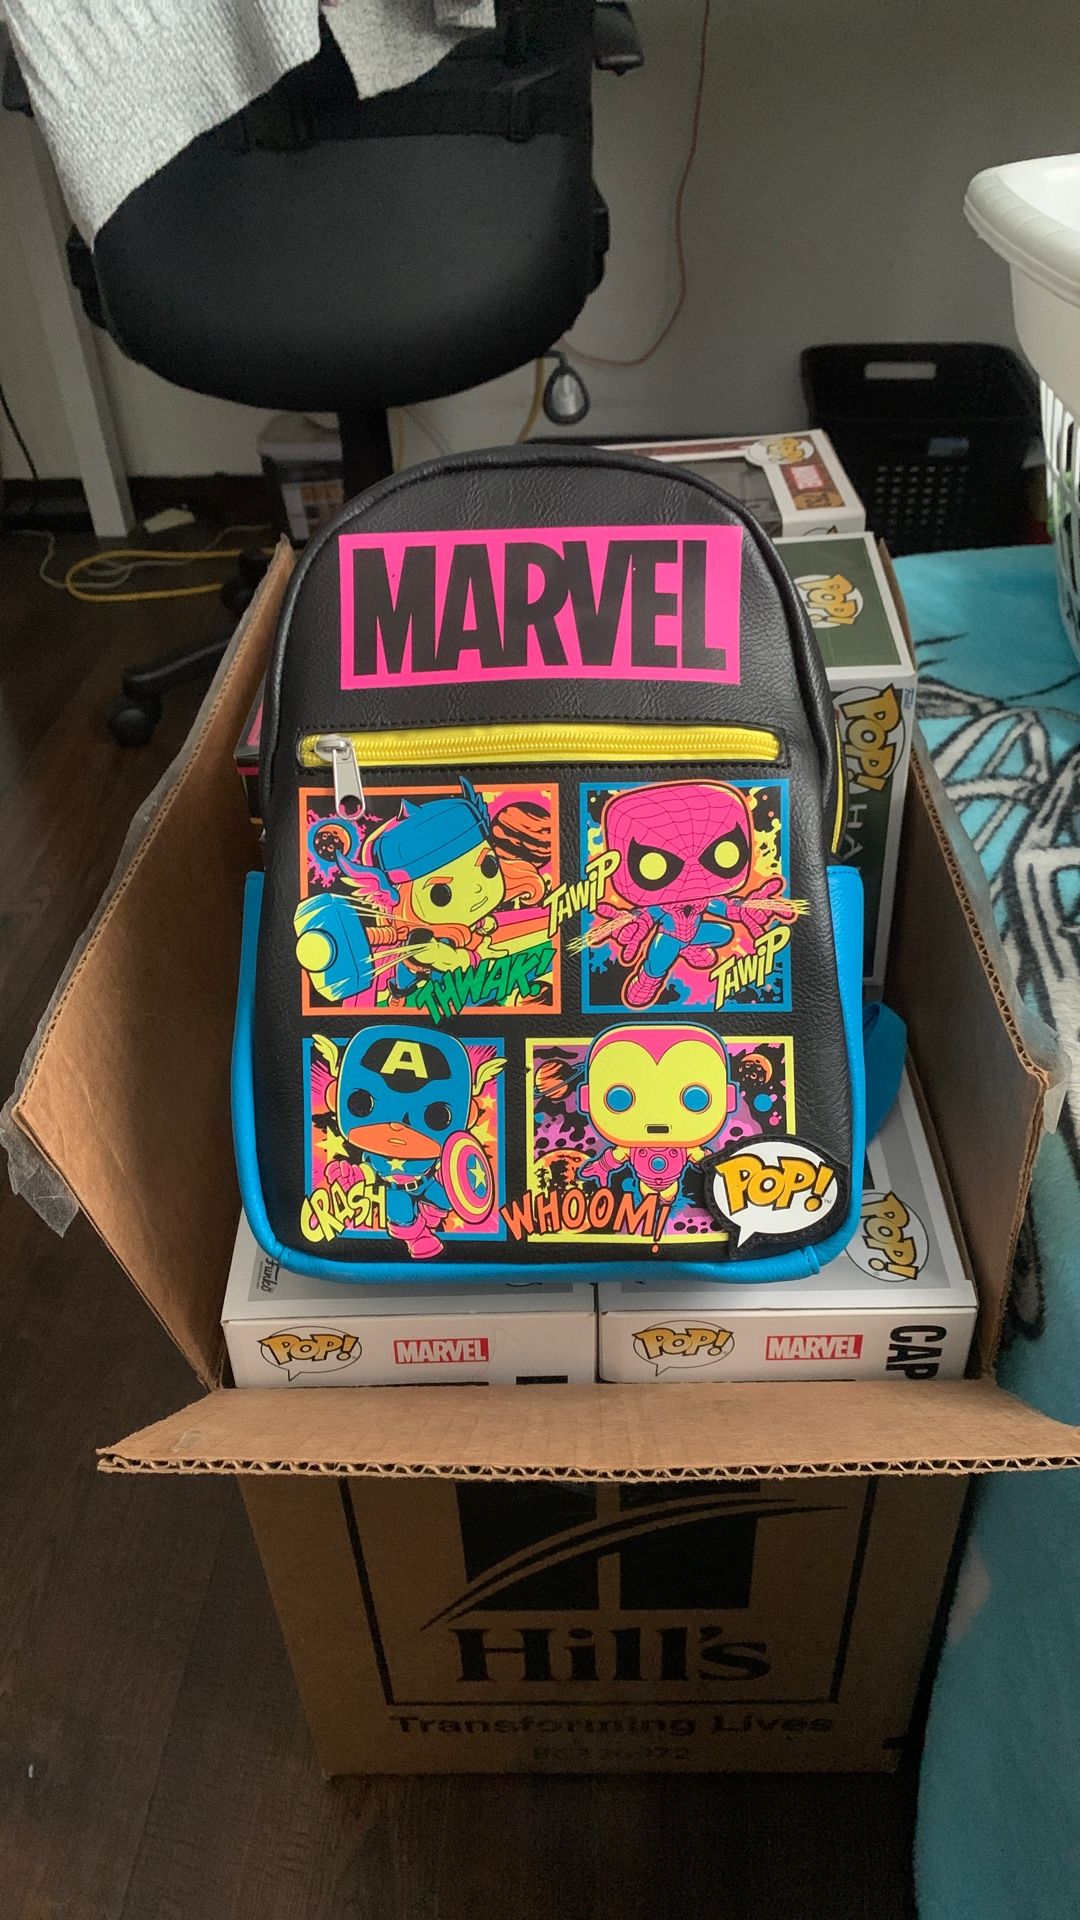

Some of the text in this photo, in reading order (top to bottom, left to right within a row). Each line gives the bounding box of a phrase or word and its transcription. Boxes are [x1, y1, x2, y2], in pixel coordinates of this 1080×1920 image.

[353, 539, 727, 677] MARVEL
[839, 683, 901, 791] POP!
[415, 947, 558, 1025] THWAK!
[380, 1040, 429, 1079] A
[300, 1180, 387, 1243] CRASH
[714, 1153, 836, 1217] POP!
[500, 1186, 672, 1255] WHOOM!
[861, 1190, 919, 1281] POP!
[257, 1333, 488, 1366] POP! MARVEL
[632, 1327, 863, 1360] POP! MARVEL
[885, 1324, 948, 1381] CAP
[448, 1626, 772, 1682] Hill's
[388, 1712, 835, 1737] Transforming Lives
